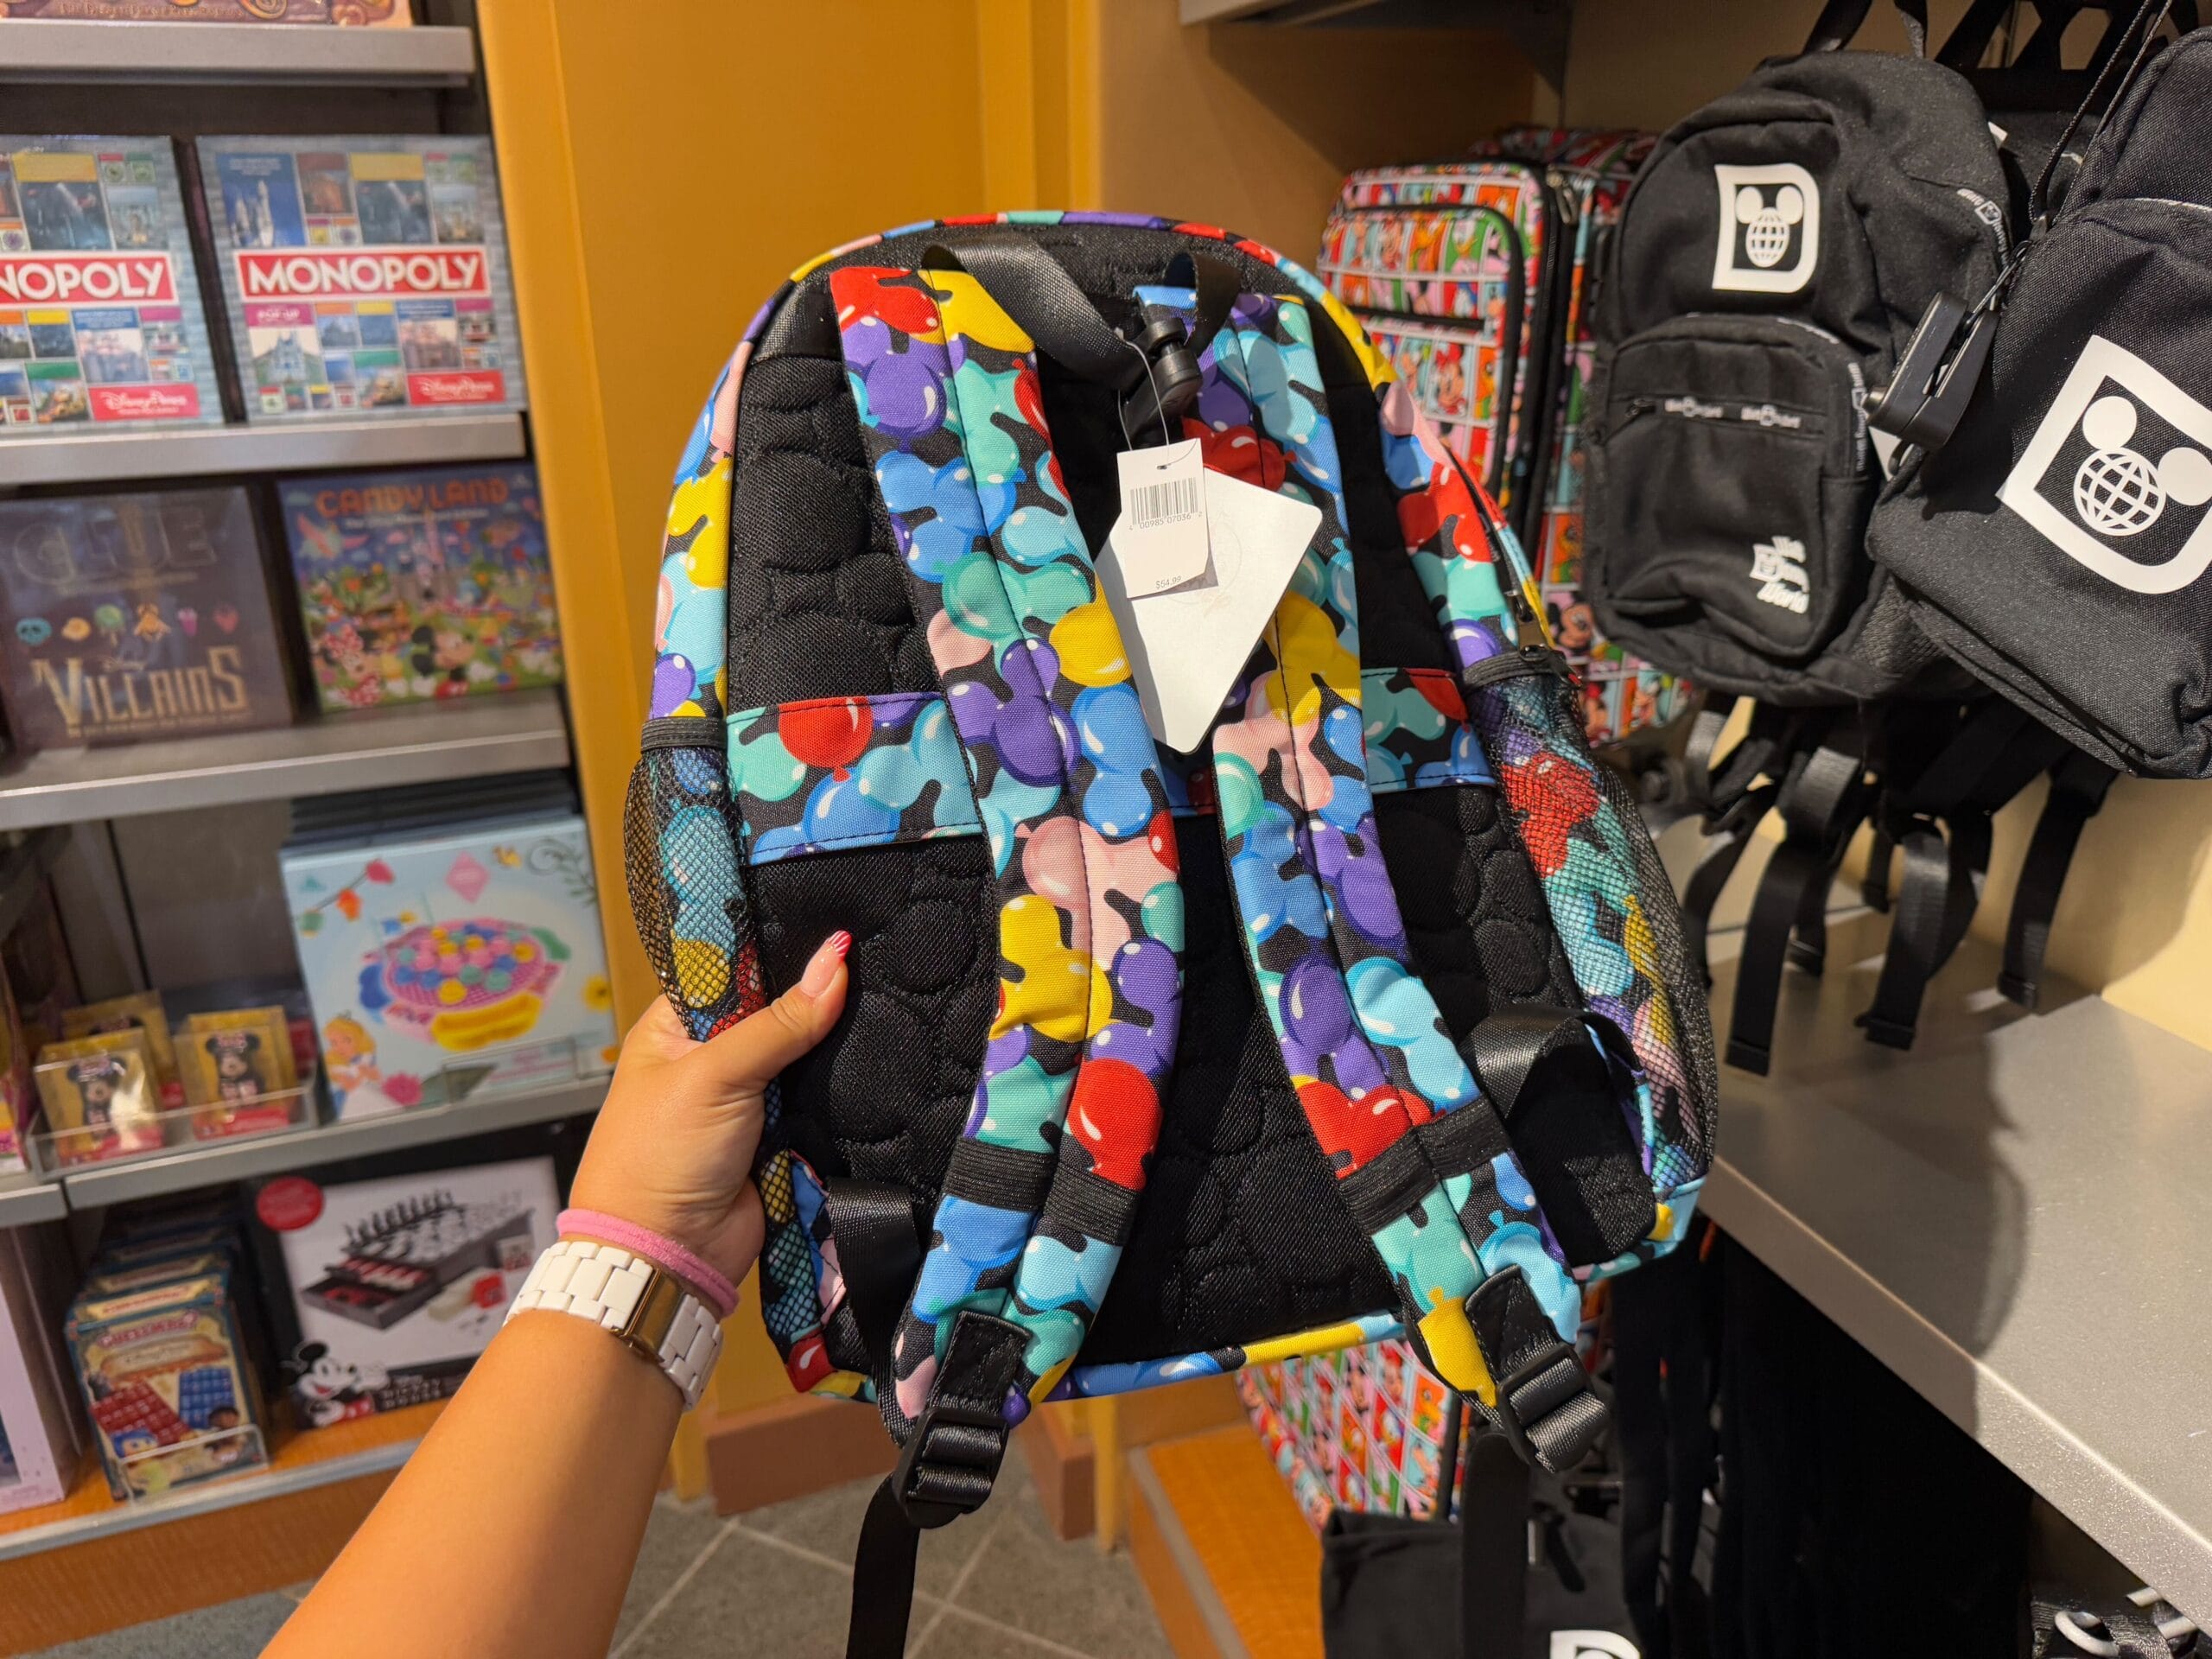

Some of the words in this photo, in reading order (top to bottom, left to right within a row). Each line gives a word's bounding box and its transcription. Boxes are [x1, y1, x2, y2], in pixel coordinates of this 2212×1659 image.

[248, 255, 480, 294] MONOPOLY
[315, 485, 425, 518] CANDY
[429, 476, 510, 510] LAND
[1155, 575, 1182, 589] $54.99
